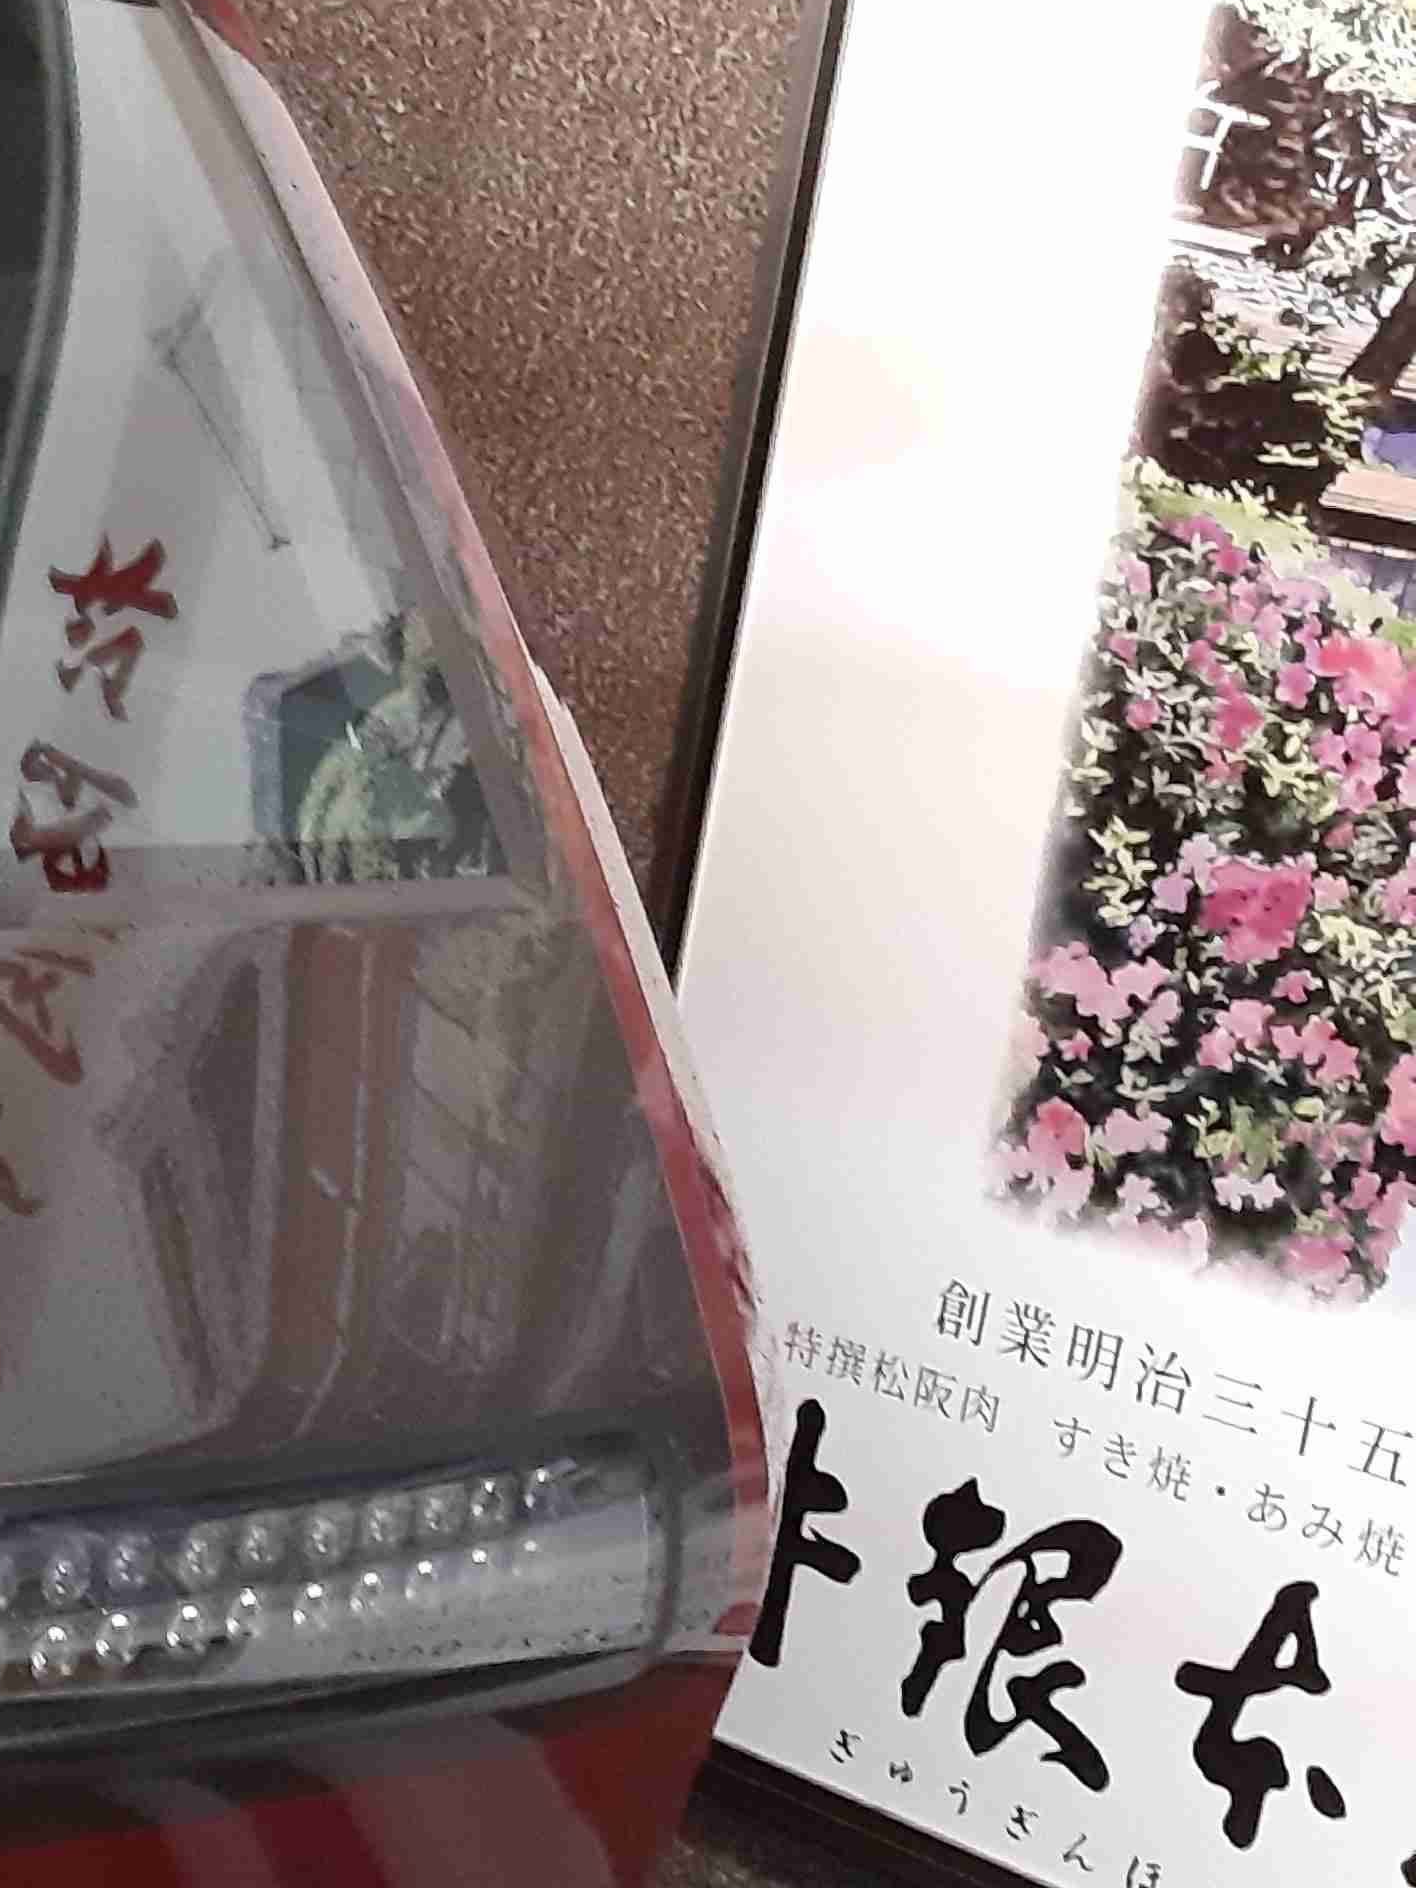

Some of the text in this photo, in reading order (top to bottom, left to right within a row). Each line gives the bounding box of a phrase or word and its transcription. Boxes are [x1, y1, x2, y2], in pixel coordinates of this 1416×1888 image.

[782, 1320, 1001, 1433] 特撰松阪肉
[934, 1278, 1410, 1488] 創業明治三十五
